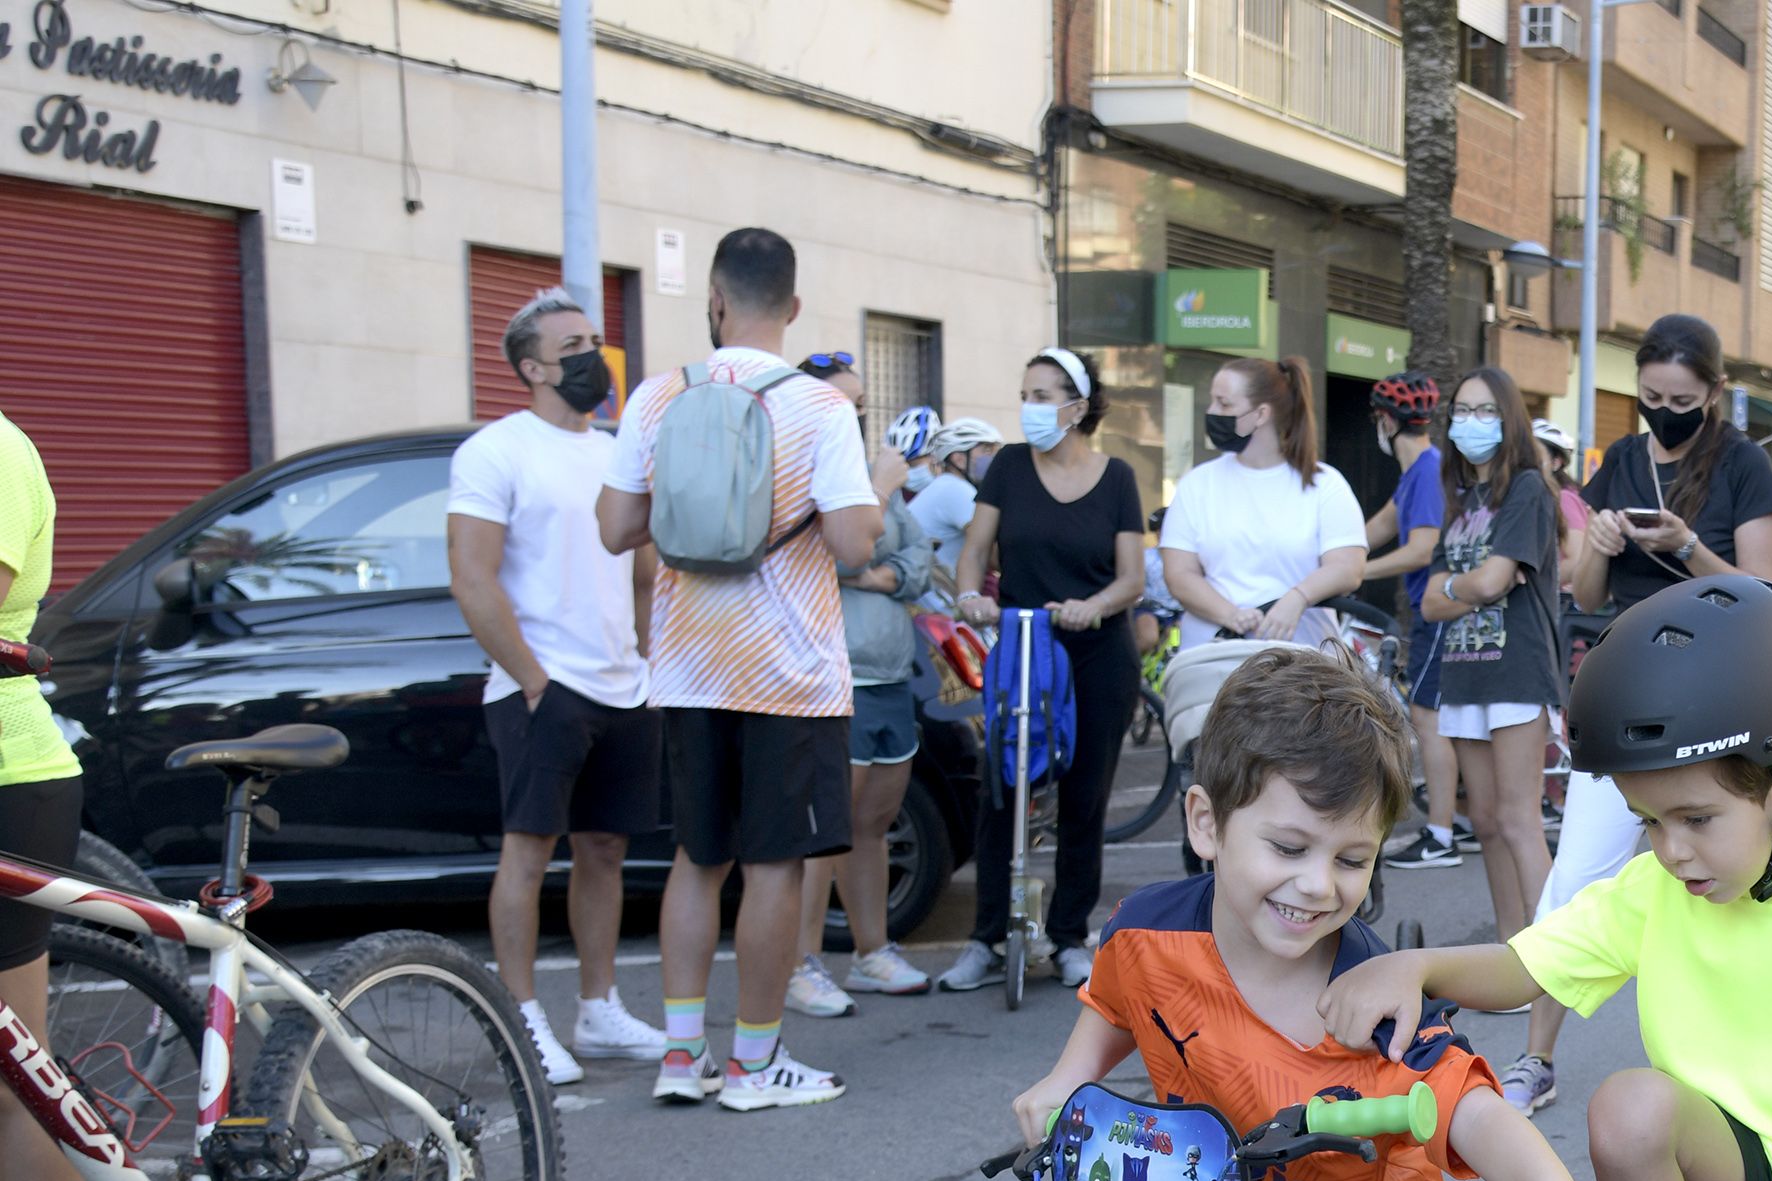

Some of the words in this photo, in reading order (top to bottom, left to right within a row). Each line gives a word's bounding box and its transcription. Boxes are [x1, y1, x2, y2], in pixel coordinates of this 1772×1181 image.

[20, 94, 160, 173] Rial
[1181, 314, 1252, 328] IBERDROLA
[0, 1001, 125, 1169] RBEA
